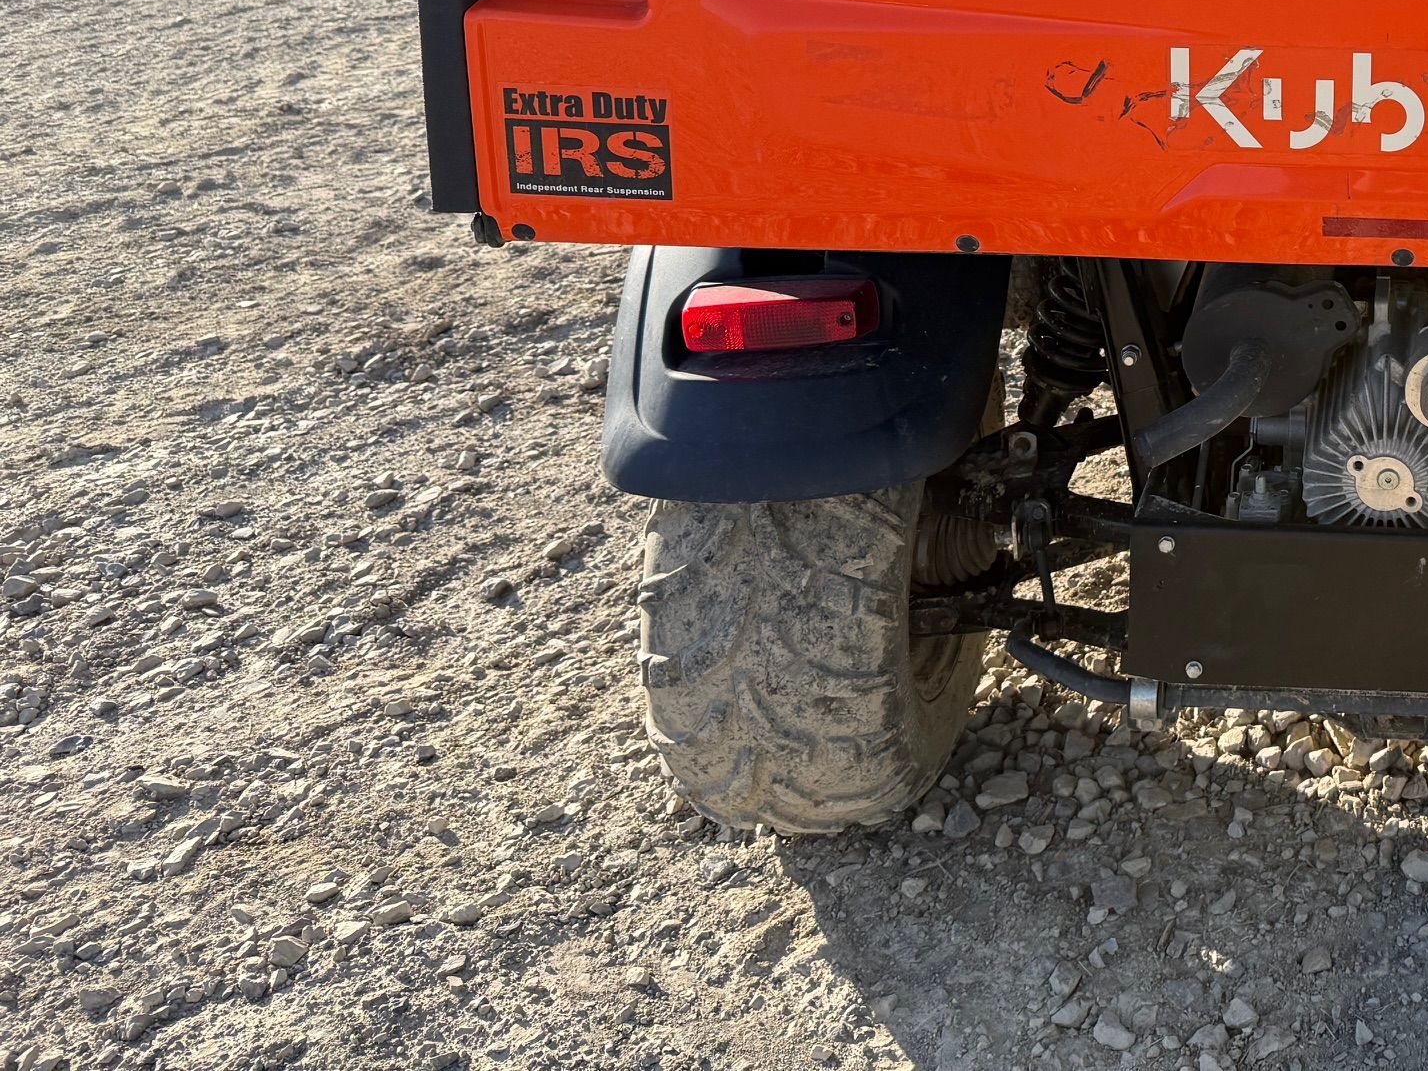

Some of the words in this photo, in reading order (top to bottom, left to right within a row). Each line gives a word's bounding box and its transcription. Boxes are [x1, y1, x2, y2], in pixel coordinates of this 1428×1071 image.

[503, 87, 584, 118] Extra
[592, 91, 667, 124] Duty
[512, 126, 666, 179] IRS
[516, 182, 578, 193] Independent
[581, 185, 604, 193] Rear
[606, 186, 665, 196] Suspension
